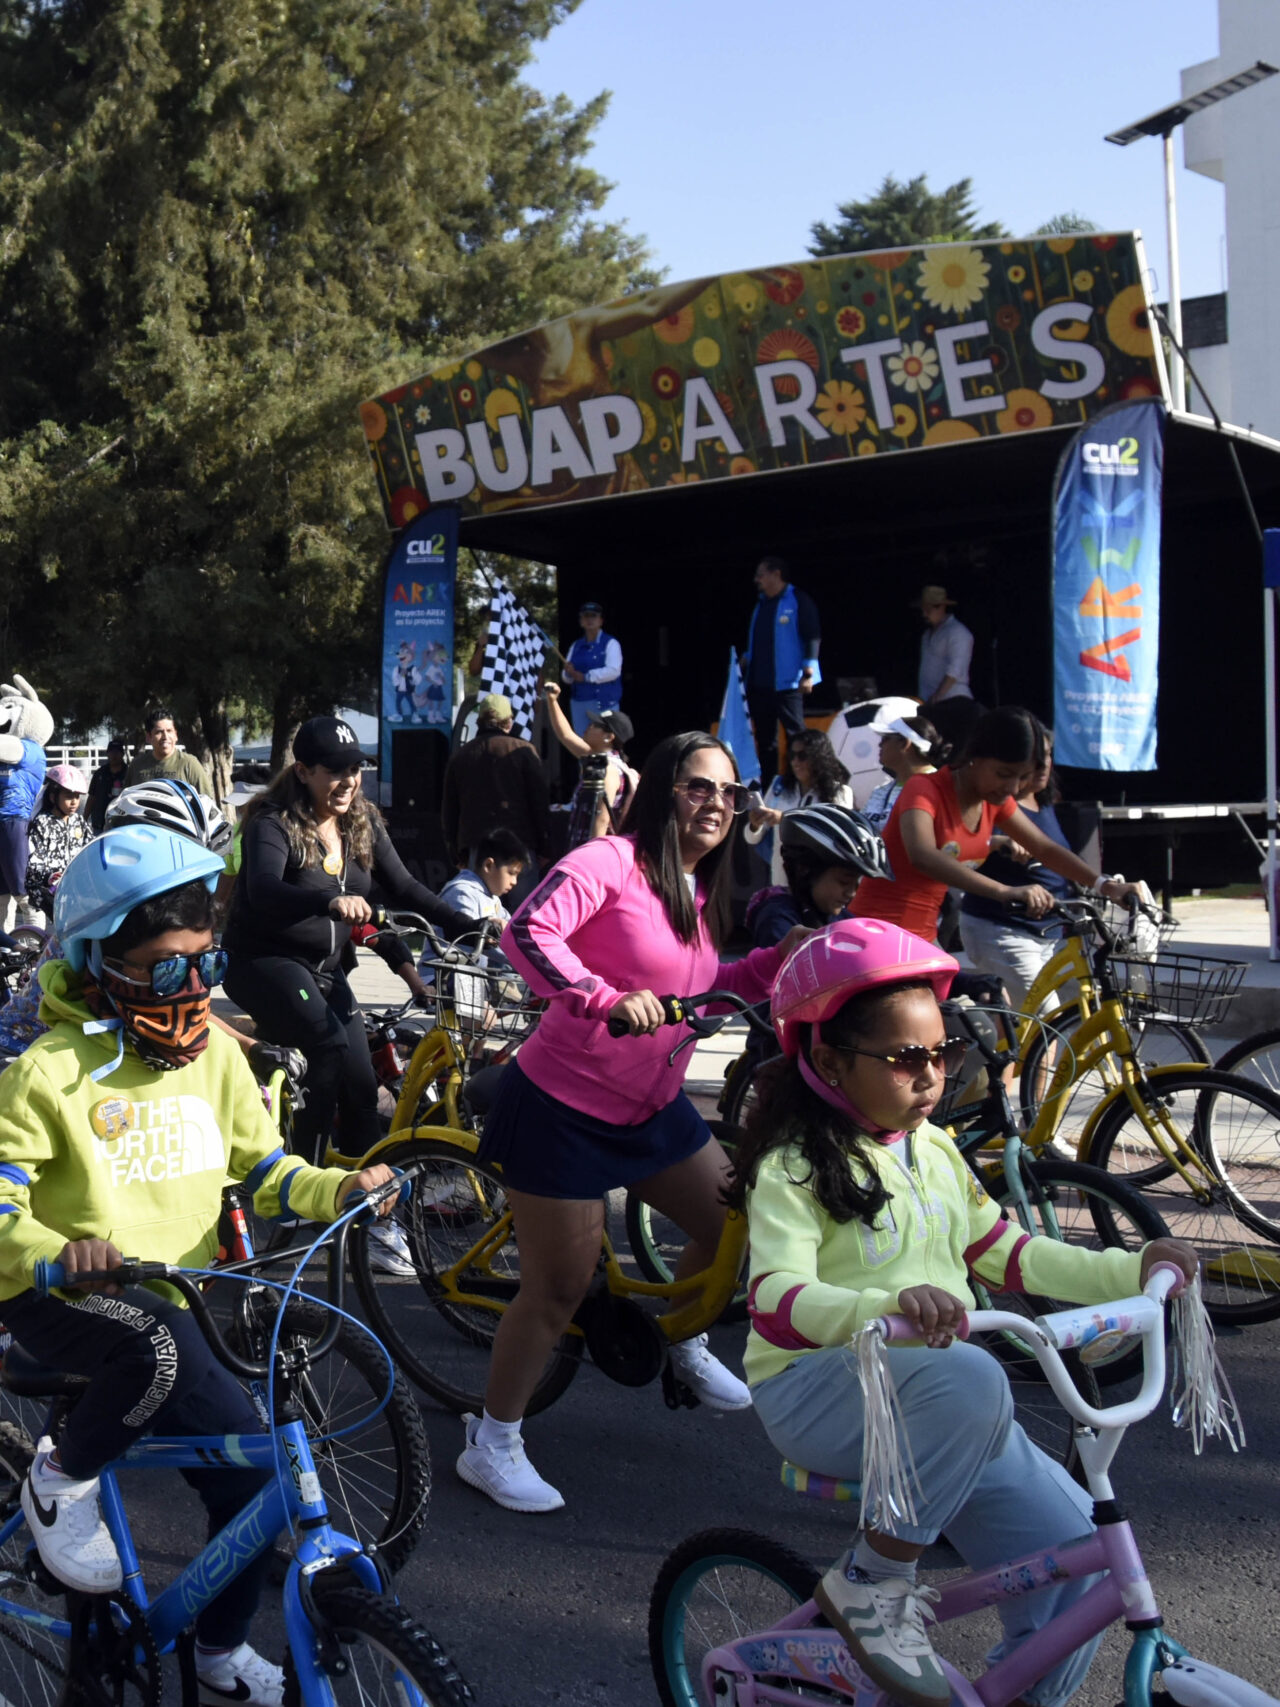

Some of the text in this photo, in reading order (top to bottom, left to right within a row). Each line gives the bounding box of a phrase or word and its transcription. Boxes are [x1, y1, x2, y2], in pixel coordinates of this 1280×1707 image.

[414, 301, 1106, 503] BUAP ARTES
[1082, 437, 1139, 465] cu2
[407, 534, 445, 555] cu2
[132, 1096, 180, 1129] THE
[110, 1152, 181, 1188] FACE
[123, 1324, 178, 1427] ORIGINAL
[181, 1492, 266, 1614] NEXT
